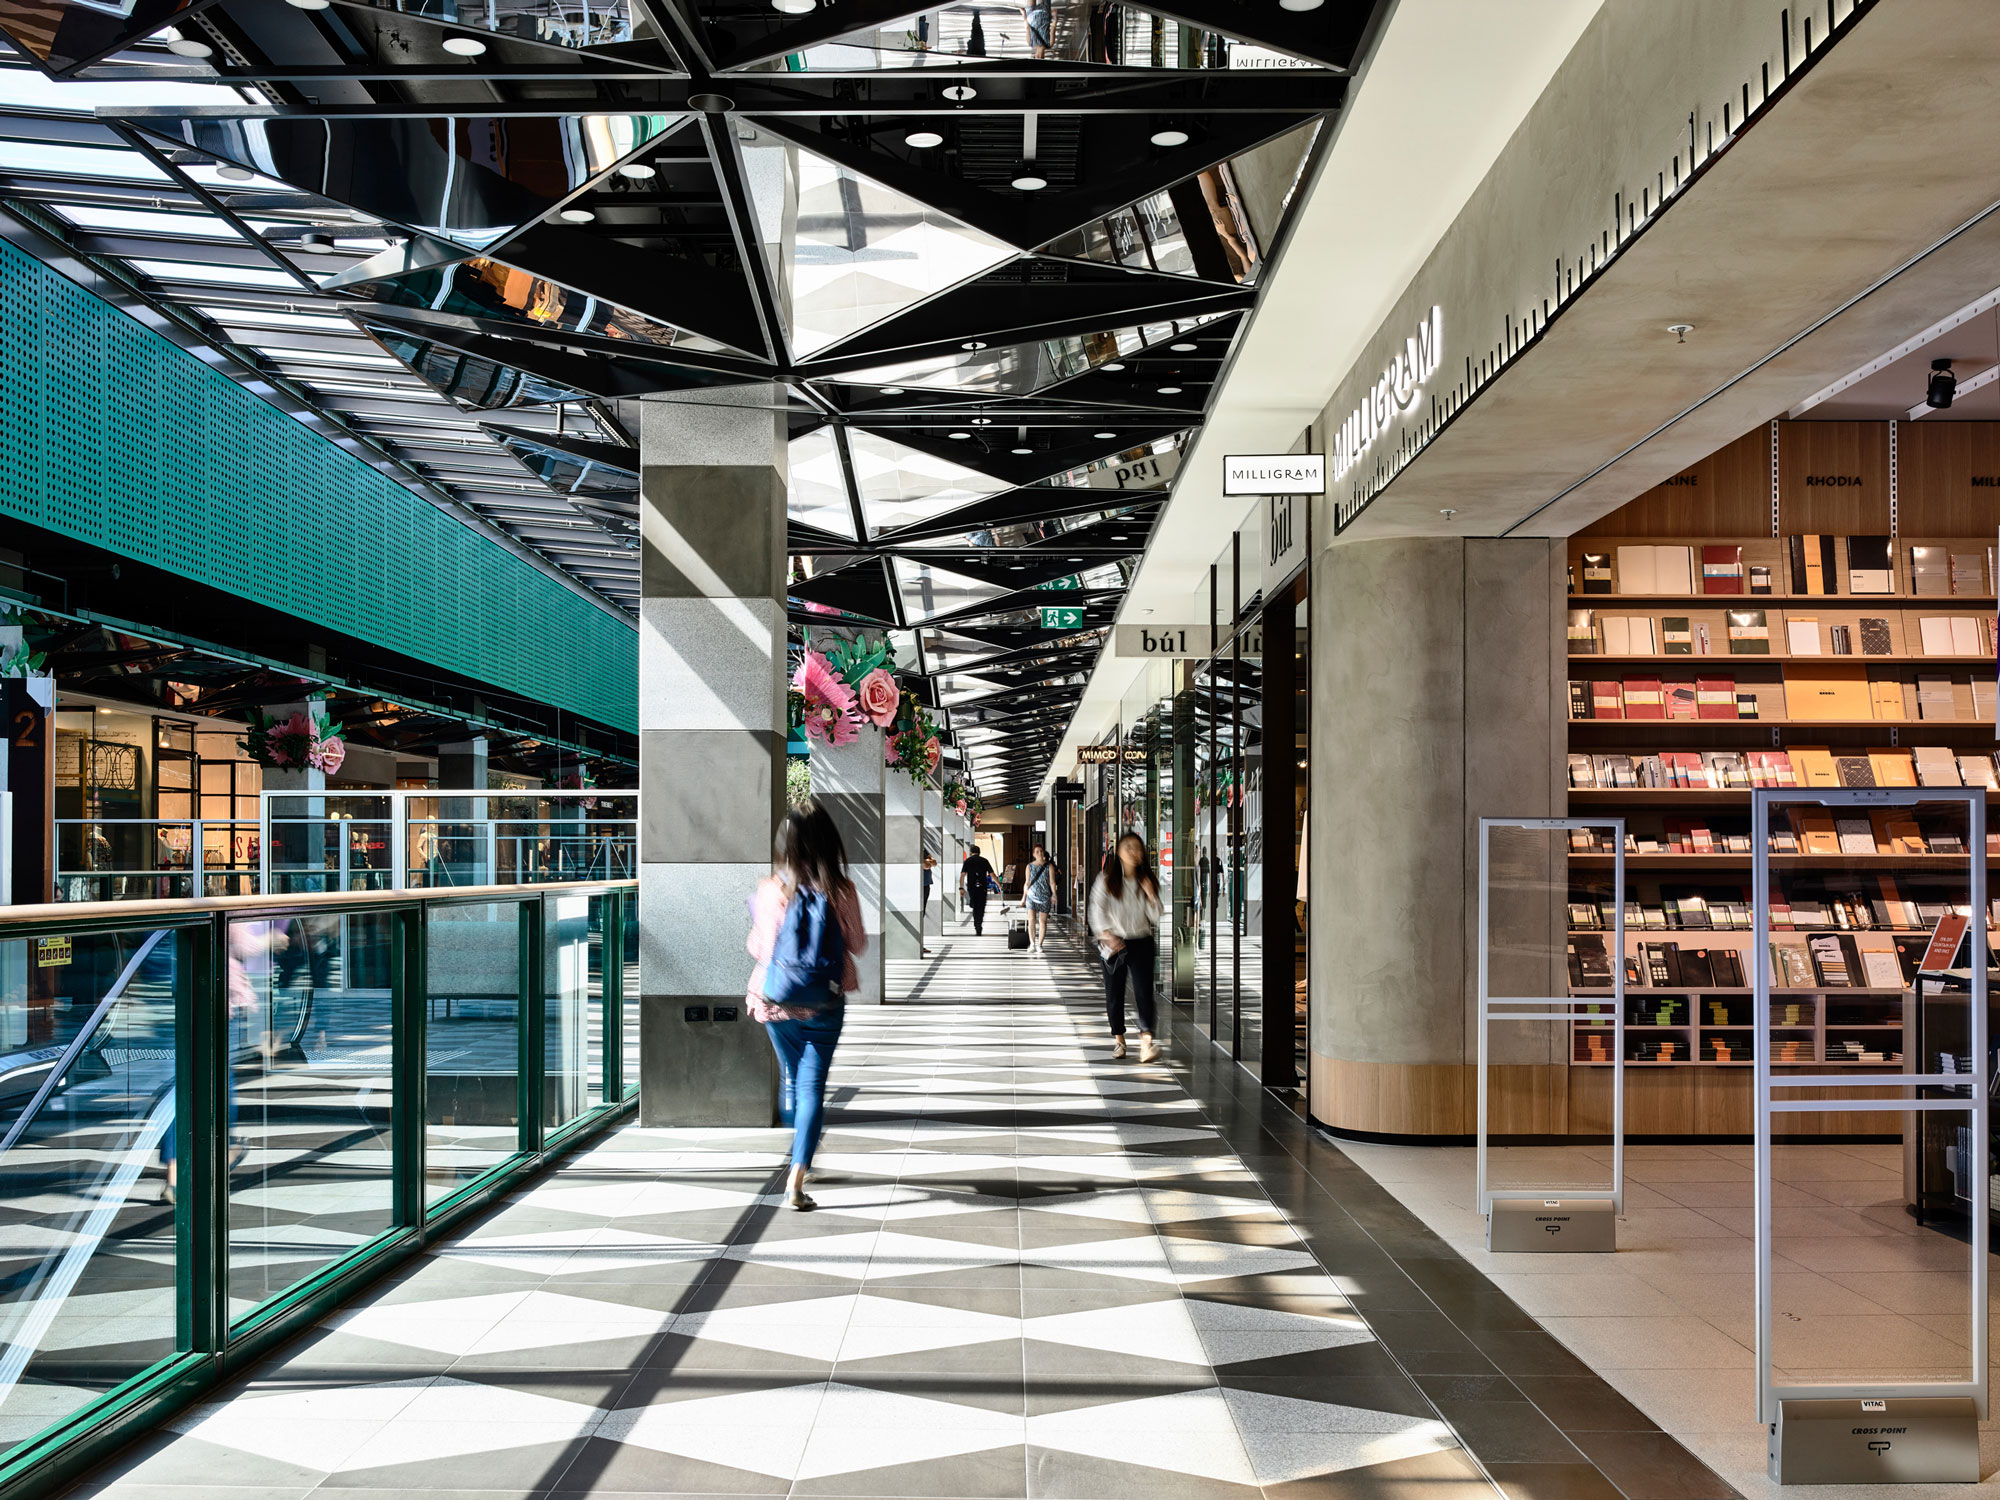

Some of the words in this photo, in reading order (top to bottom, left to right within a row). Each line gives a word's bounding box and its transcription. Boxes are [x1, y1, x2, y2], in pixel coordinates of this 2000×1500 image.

[1333, 305, 1440, 482] MILLIGRAM
[1232, 469, 1318, 481] MILLIGRAM
[1806, 476, 1862, 487] RHODIA
[1140, 629, 1187, 653] búl
[15, 711, 36, 747] 2
[1081, 750, 1117, 760] MIMCO
[1851, 1427, 1878, 1435] CROSS
[1880, 1427, 1907, 1435] POINT
